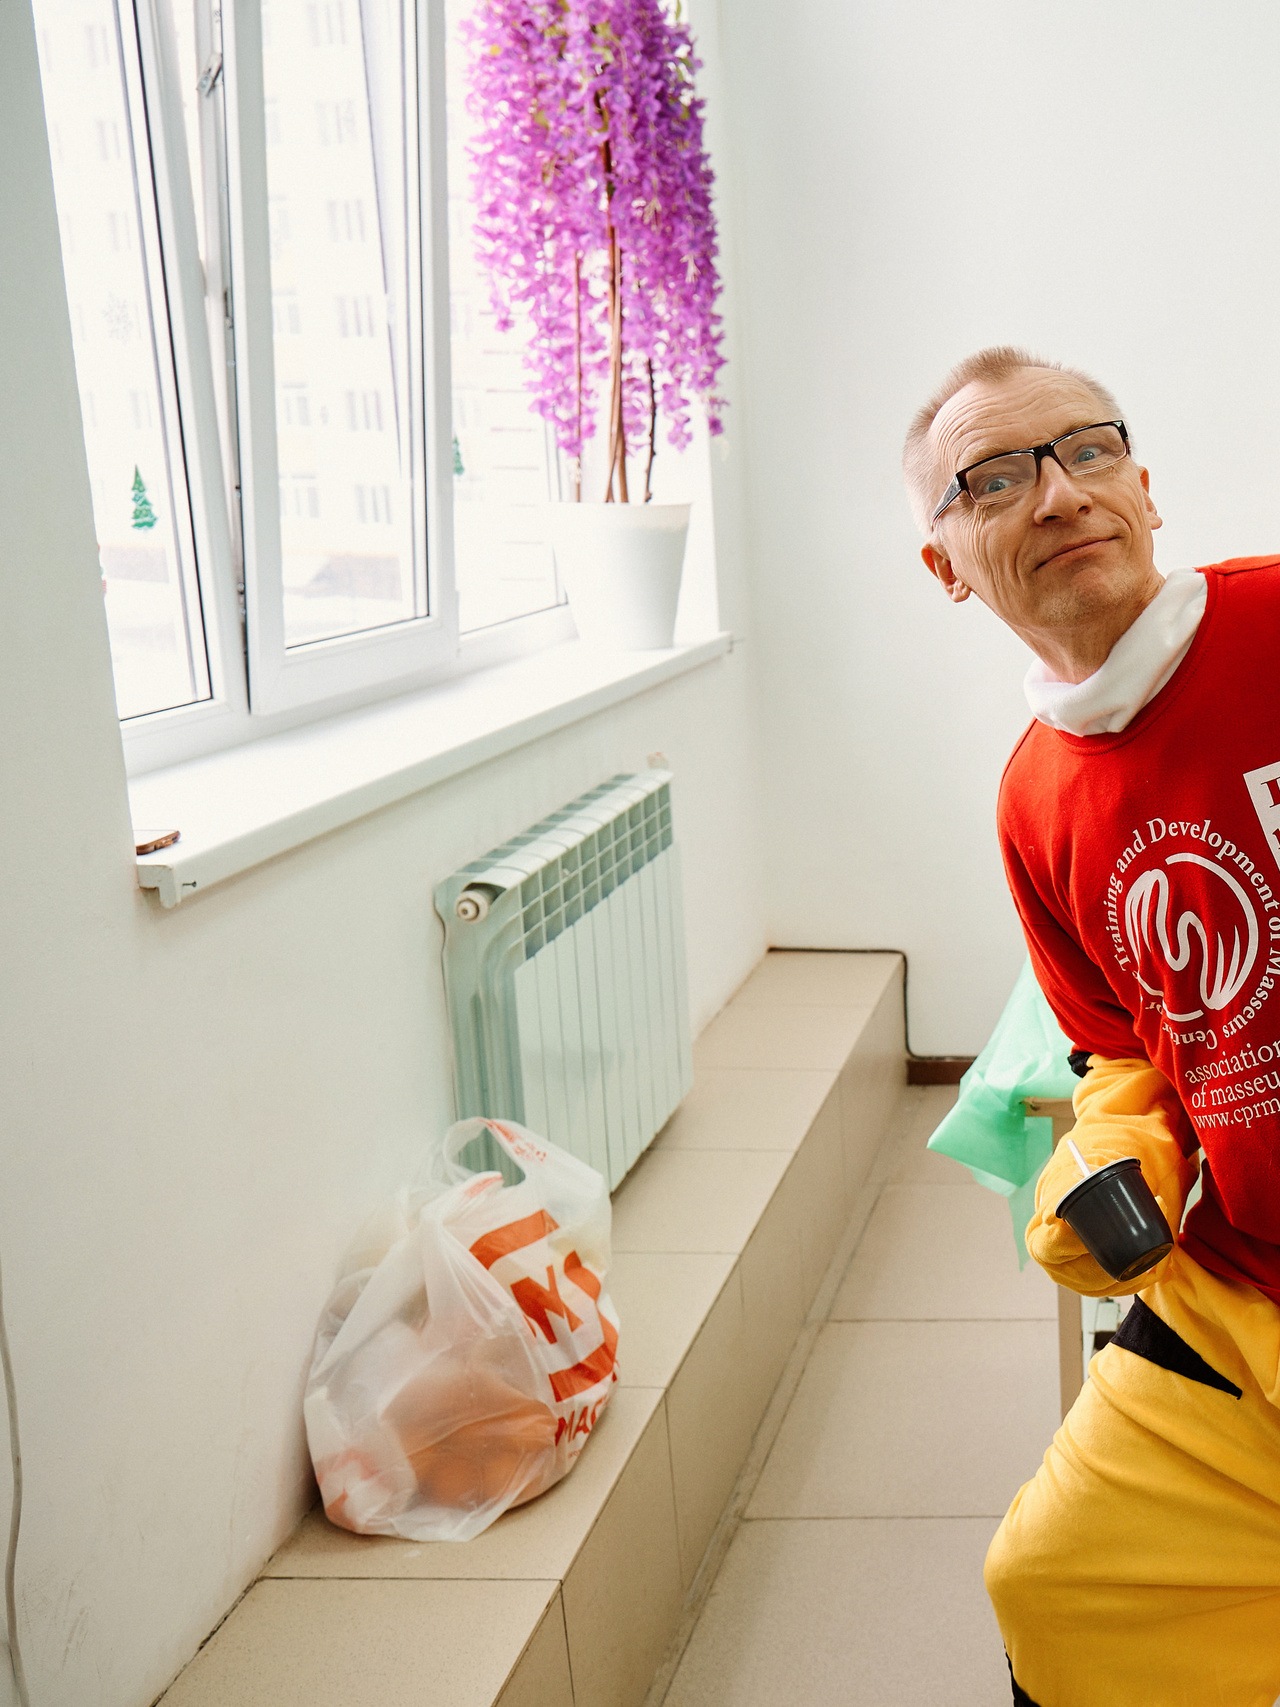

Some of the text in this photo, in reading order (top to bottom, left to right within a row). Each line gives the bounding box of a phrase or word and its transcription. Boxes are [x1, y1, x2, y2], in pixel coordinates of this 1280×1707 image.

[1116, 829, 1147, 873] and
[1146, 817, 1280, 912] Development
[1103, 872, 1131, 972] Training
[1191, 1081, 1208, 1109] of
